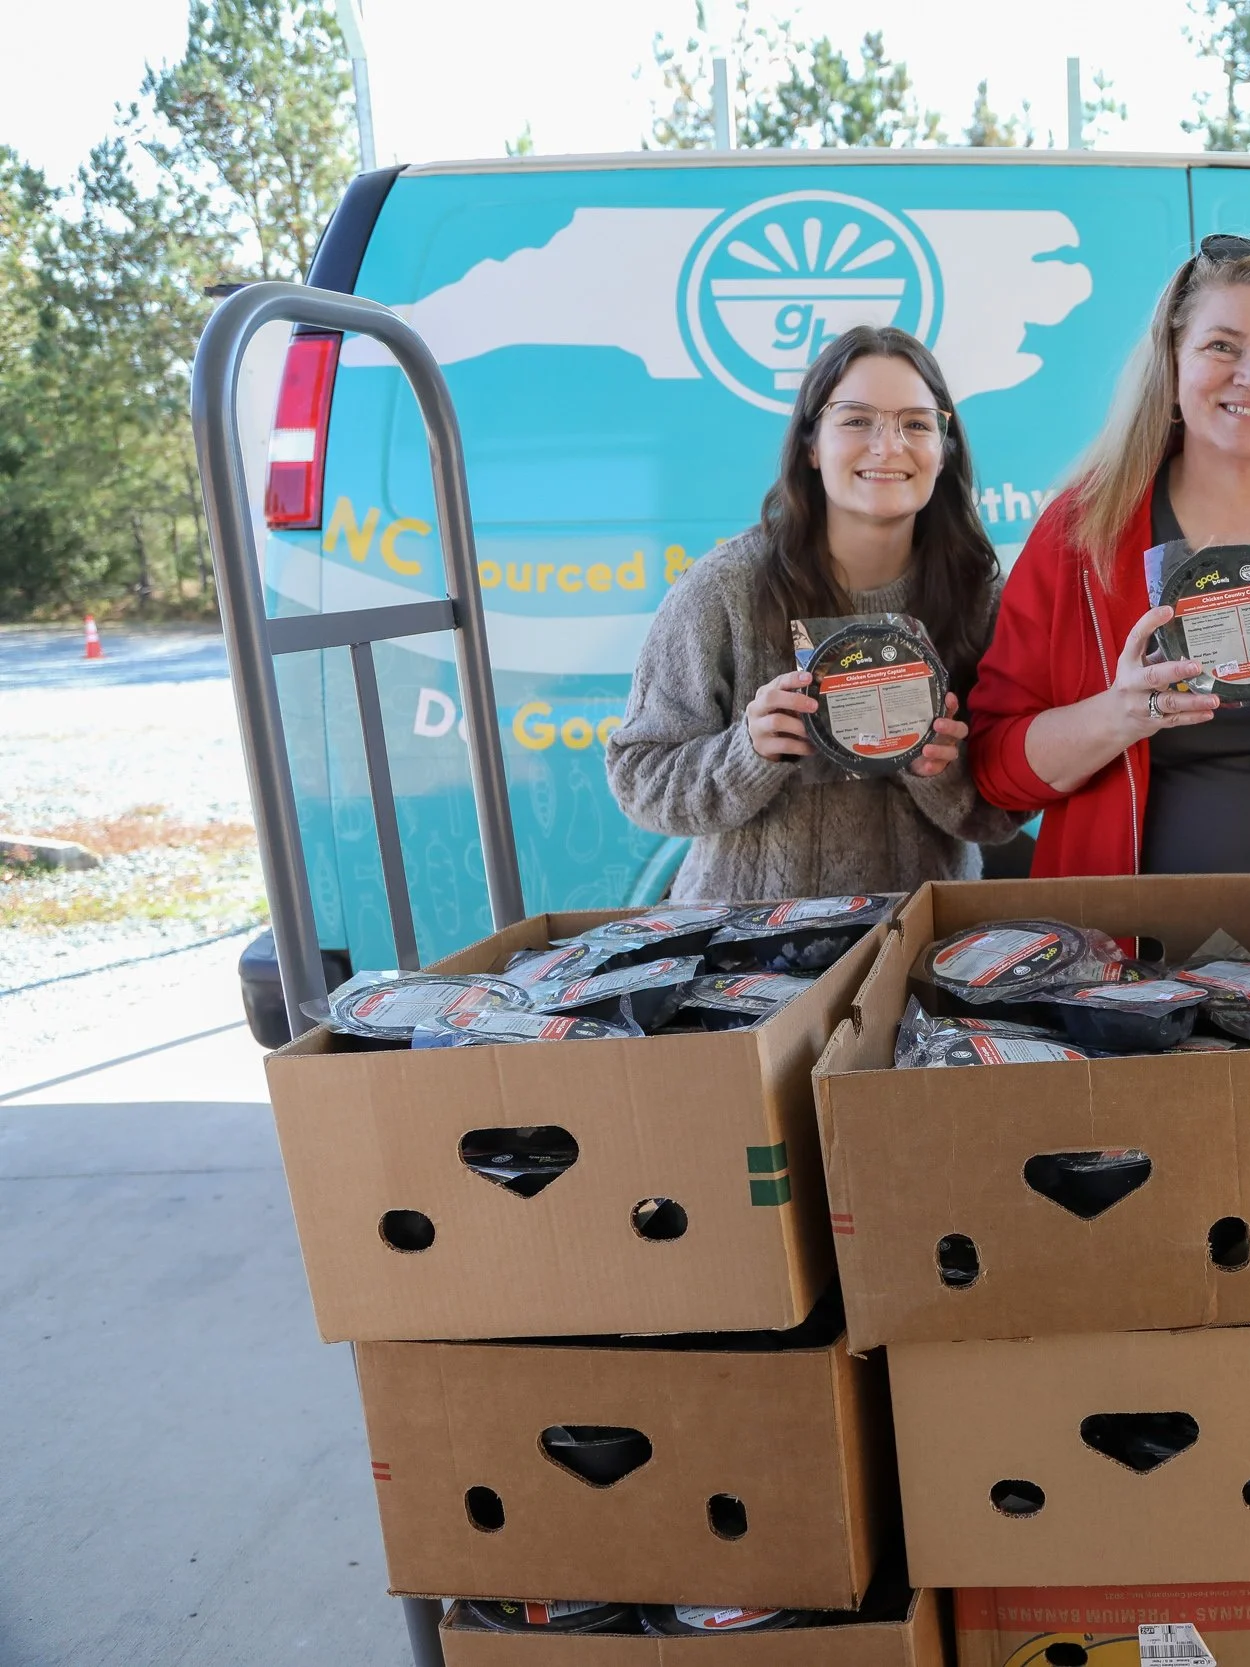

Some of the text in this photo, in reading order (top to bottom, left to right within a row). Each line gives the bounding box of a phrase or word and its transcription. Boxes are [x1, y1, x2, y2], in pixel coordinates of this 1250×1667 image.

[322, 496, 432, 576] NC
[479, 550, 646, 593] ourced
[1195, 570, 1219, 589] good
[1212, 577, 1229, 585] bowls
[1202, 595, 1223, 603] Chicken
[1224, 591, 1245, 599] Country
[840, 650, 863, 668] good
[846, 674, 866, 682] Chicken
[867, 671, 886, 679] Country
[998, 1606, 1170, 1624] PREMIUM BANANAS
